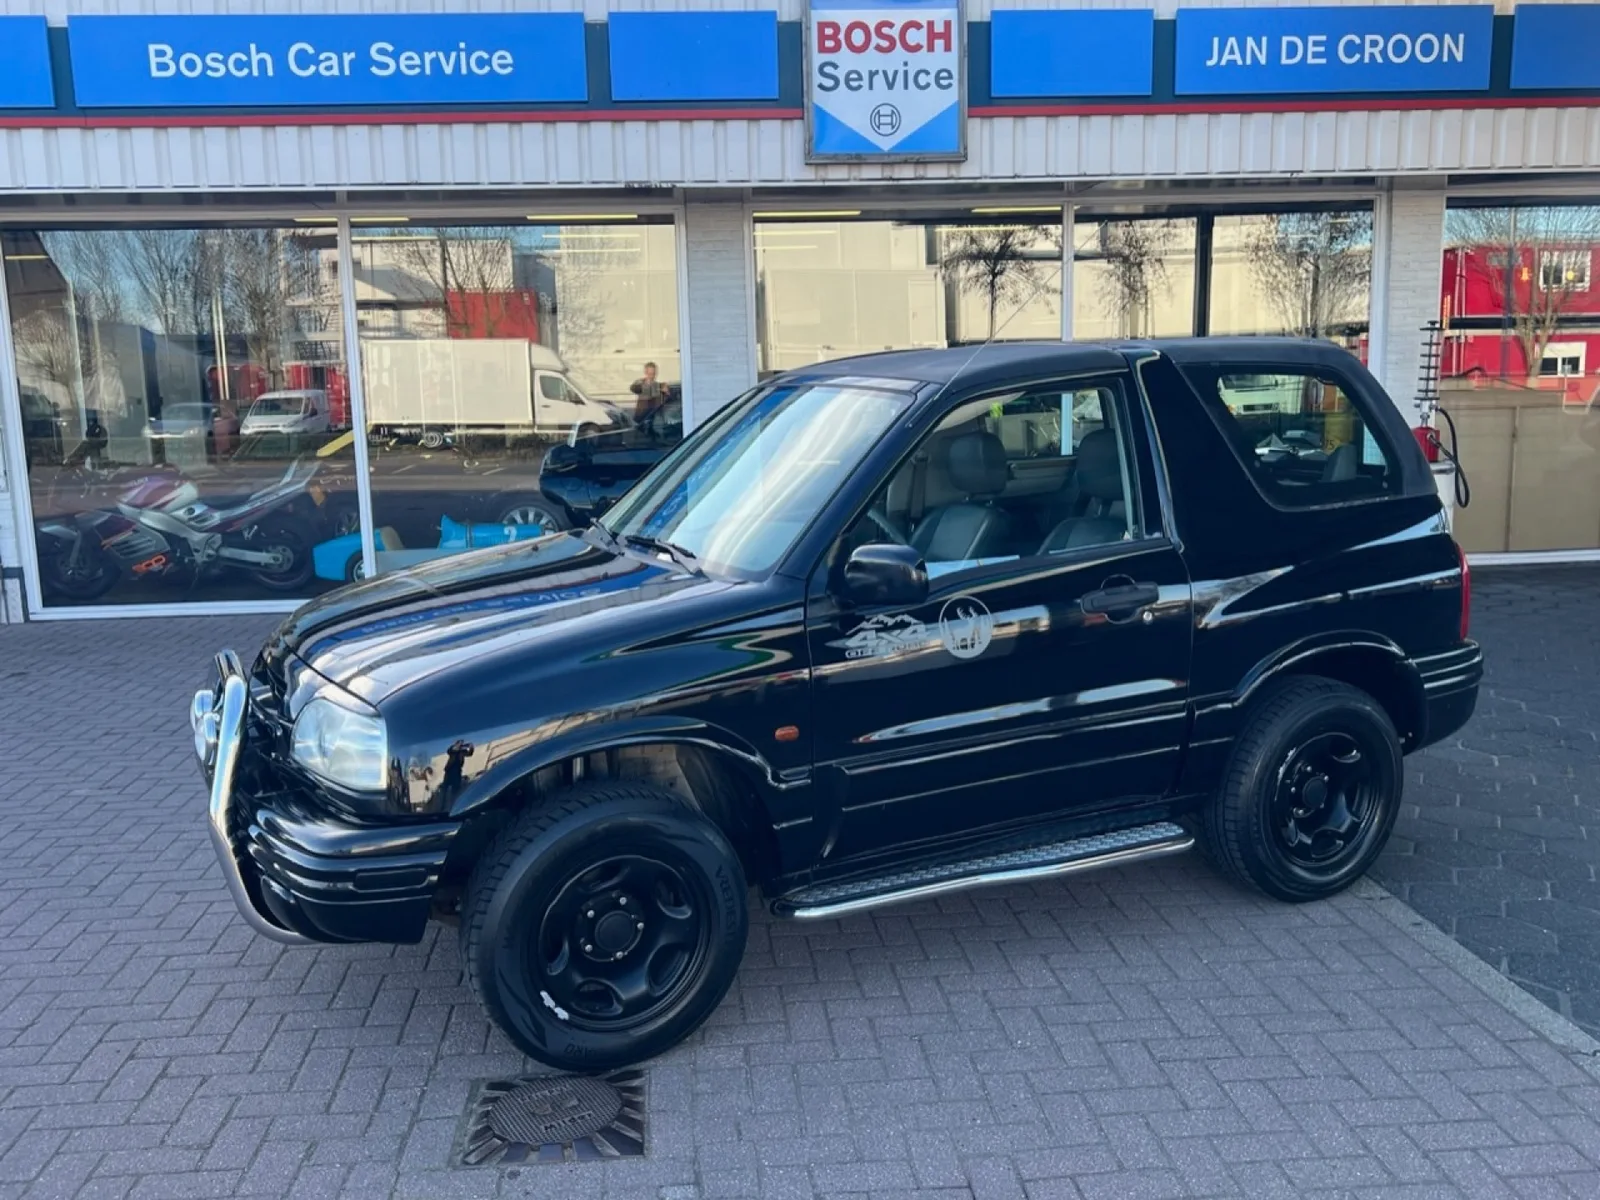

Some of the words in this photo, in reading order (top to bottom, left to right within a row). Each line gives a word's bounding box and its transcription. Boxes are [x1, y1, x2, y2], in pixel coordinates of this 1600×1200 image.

[818, 20, 952, 53] BOSCH
[1206, 36, 1267, 66] JAN
[1280, 35, 1327, 65] DE
[1338, 33, 1465, 64] CROON
[148, 43, 274, 78] Bosch
[288, 42, 356, 77] Car
[369, 42, 514, 76] Service
[816, 60, 954, 93] Service
